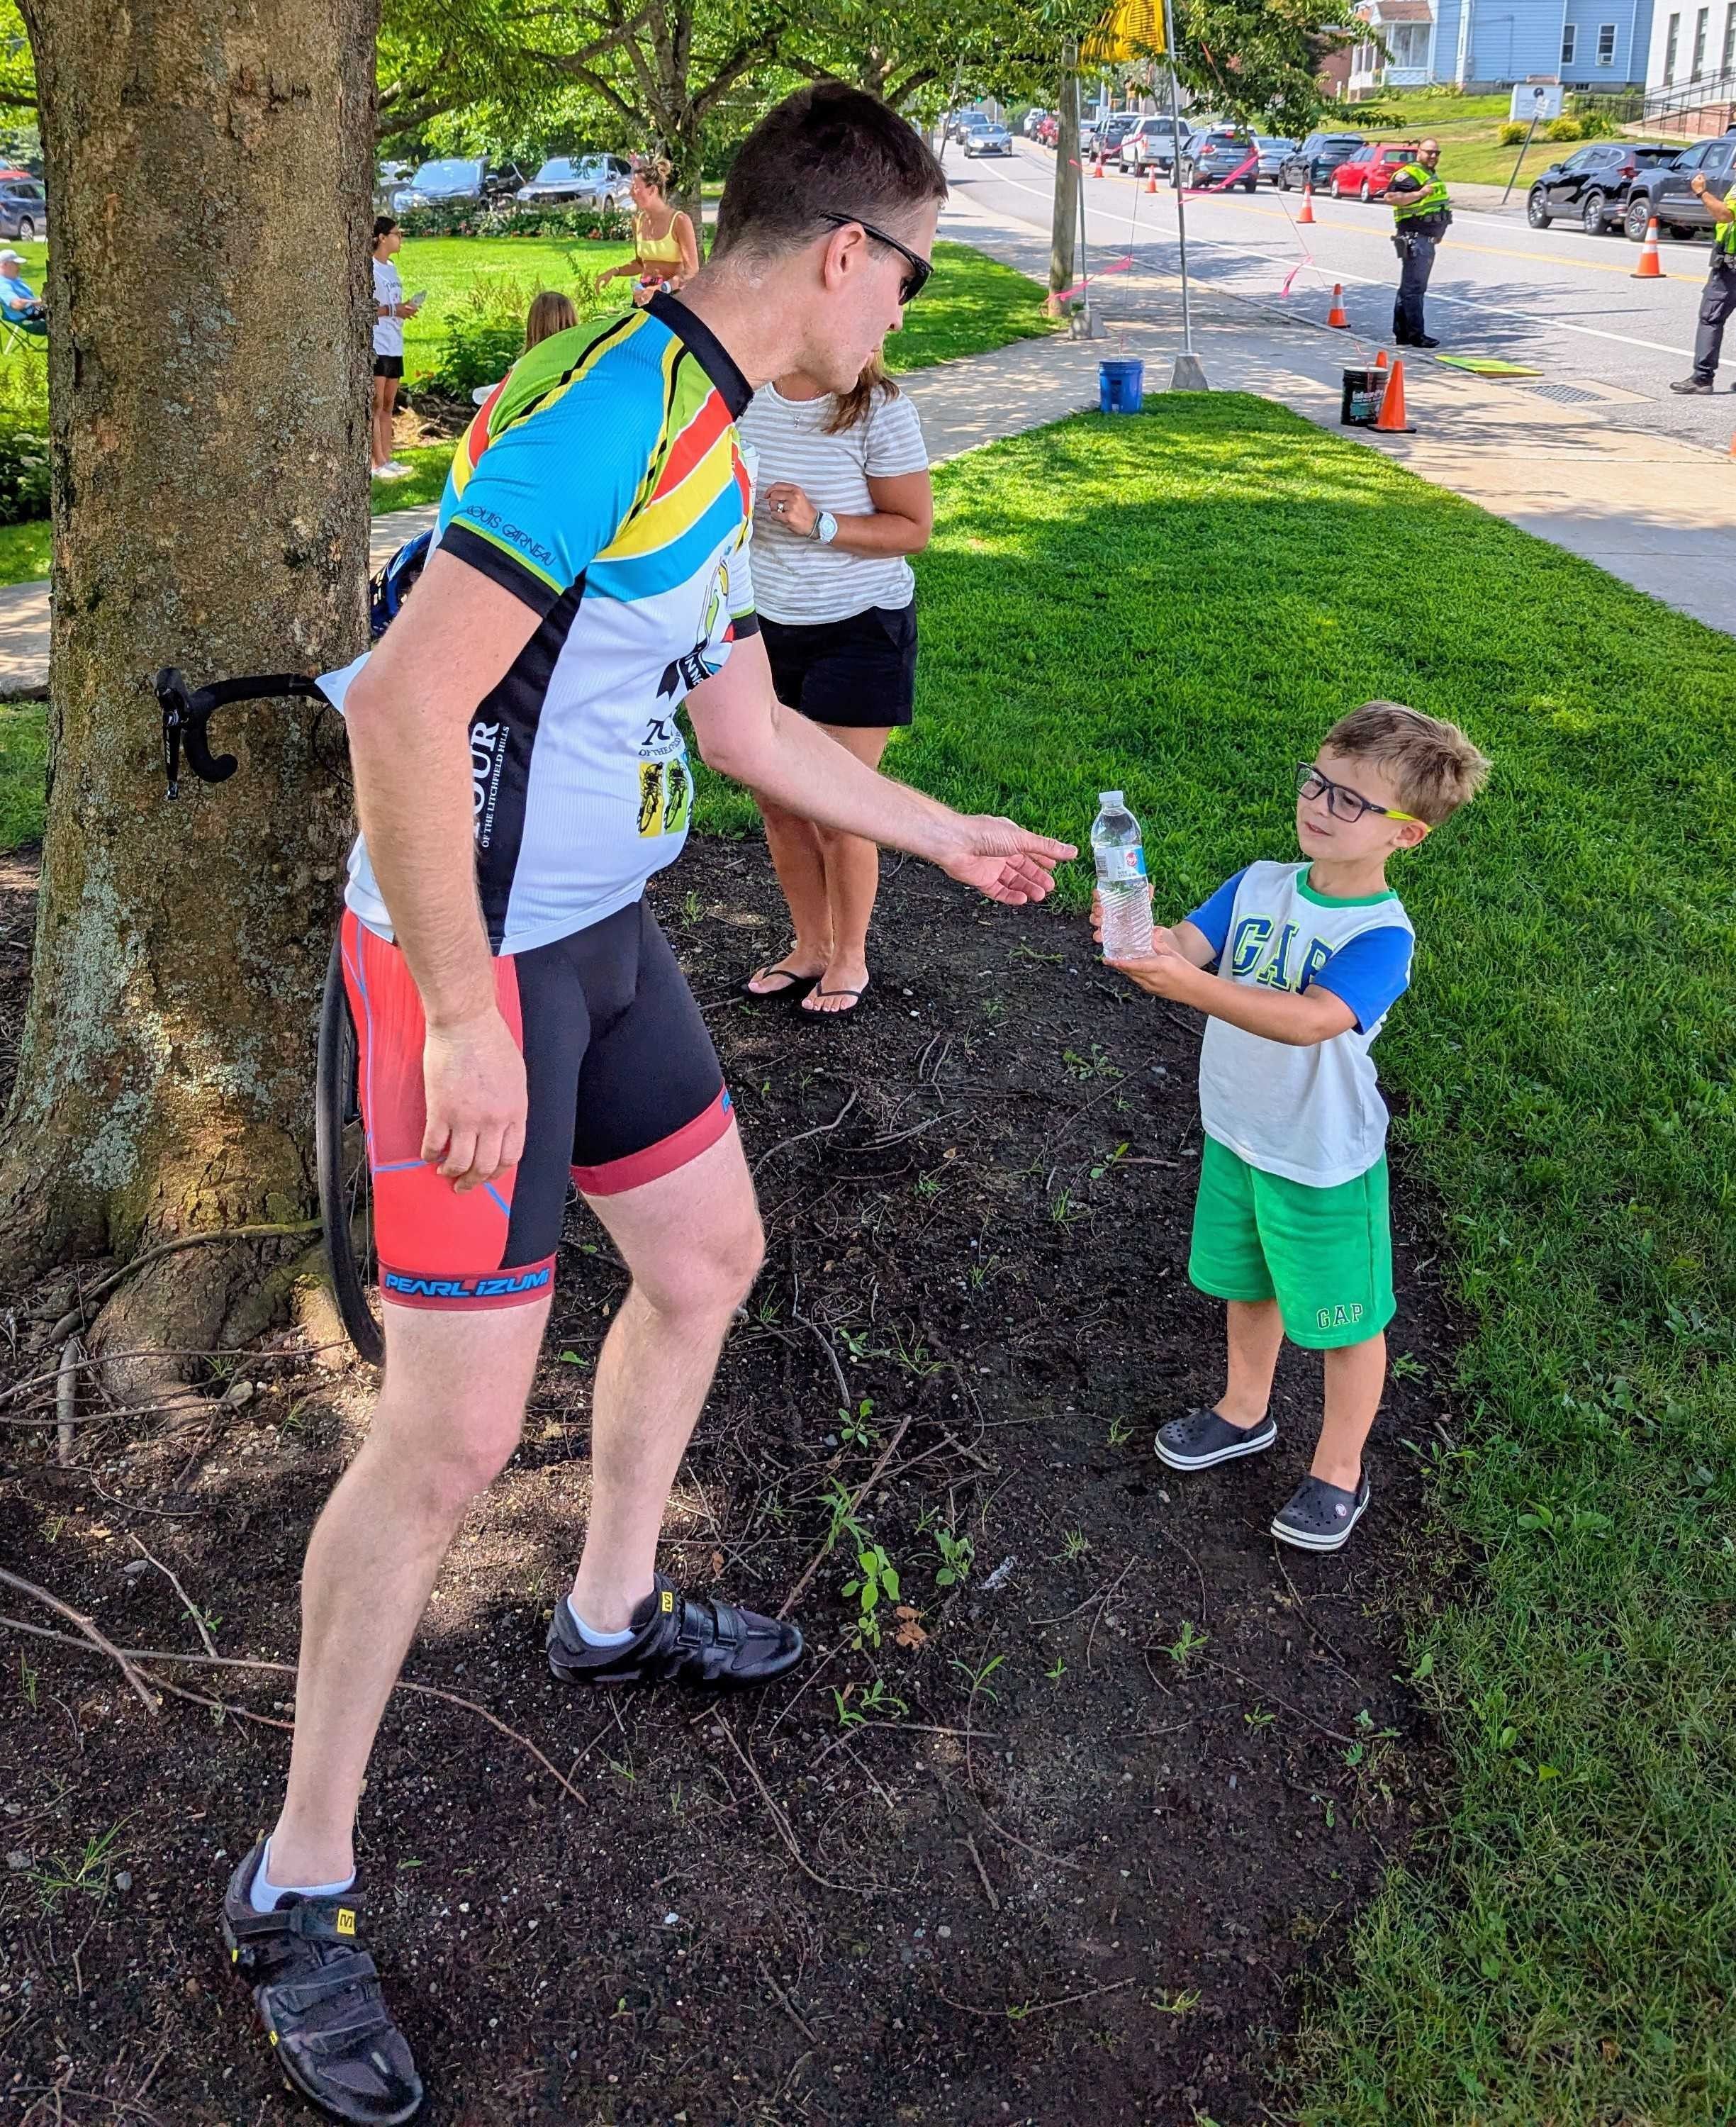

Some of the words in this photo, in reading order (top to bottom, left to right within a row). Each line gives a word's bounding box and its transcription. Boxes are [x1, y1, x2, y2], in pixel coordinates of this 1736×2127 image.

[466, 505, 502, 528] LOUIS
[502, 524, 556, 566] GARNEAU
[498, 725, 510, 752] HILLS
[487, 754, 503, 812] LITCHFIELD
[483, 813, 494, 833] THE
[481, 834, 491, 848] OF
[385, 1273, 471, 1297] PEARL
[1316, 1303, 1363, 1329] GAP
